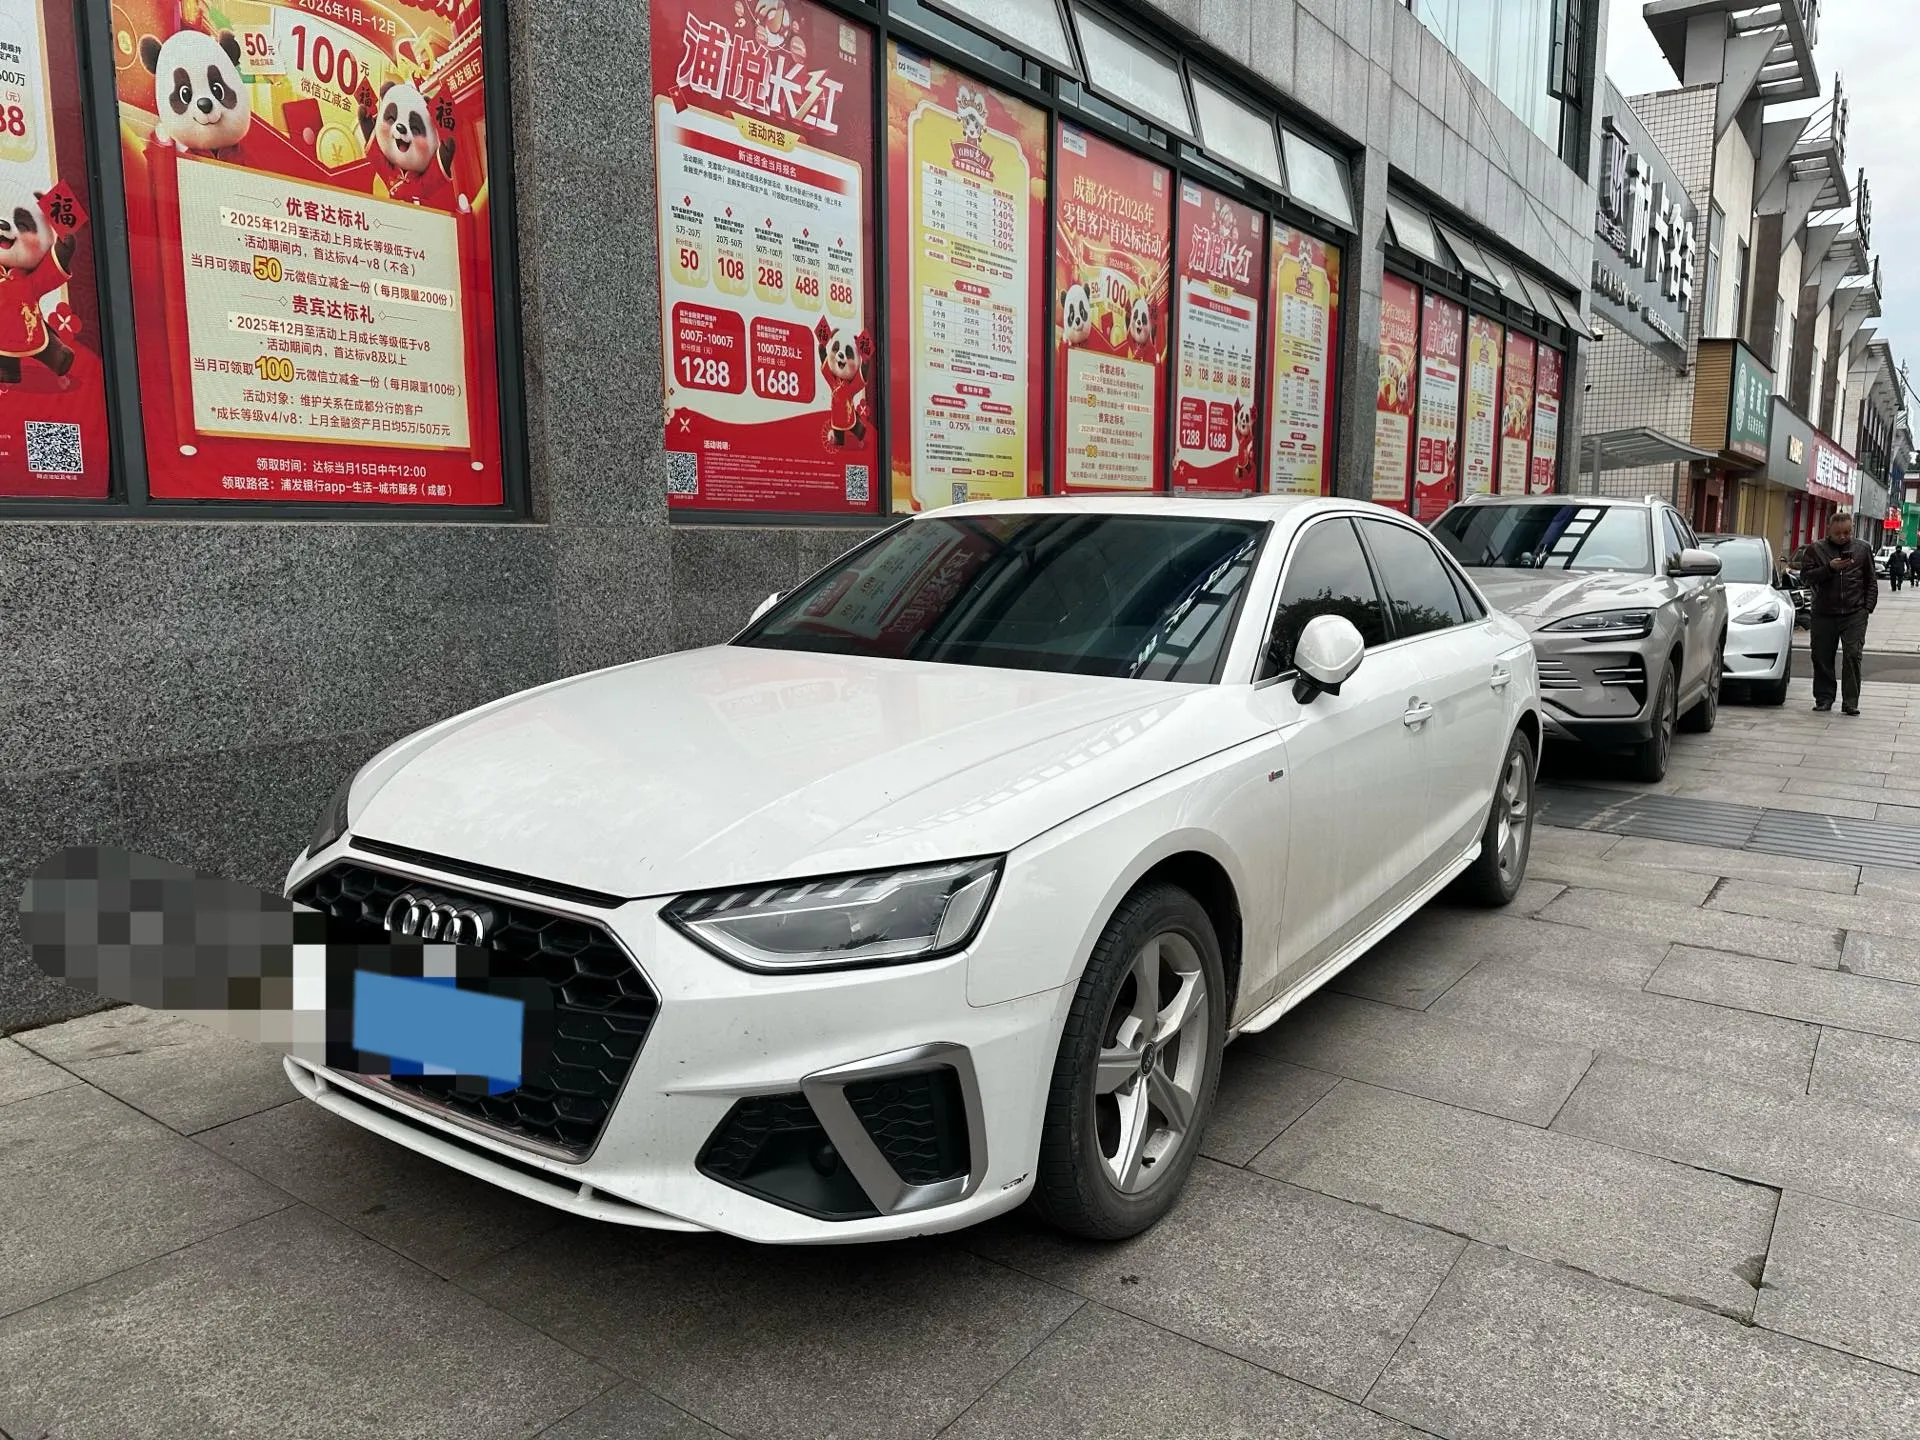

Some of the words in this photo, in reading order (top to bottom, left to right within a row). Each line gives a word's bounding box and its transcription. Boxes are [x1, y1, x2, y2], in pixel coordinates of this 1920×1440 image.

[0, 69, 25, 86] 00万
[446, 58, 481, 93] 浦发银行
[676, 12, 844, 134] 浦悦长红
[301, 79, 352, 112] 微信立减金
[436, 97, 455, 131] 福
[748, 121, 786, 147] 活动内容
[48, 195, 77, 228] 福
[993, 198, 1014, 212] 1.75%
[1072, 175, 1154, 228] 成都分行2026年
[286, 197, 369, 231] 优客达标礼
[993, 208, 1014, 222] 1.40%
[231, 212, 425, 260] 2025年12月至活动上月成长等级低于v4
[993, 228, 1014, 242] 1.20%
[1063, 201, 1162, 259] 零售客户首达标活动
[993, 239, 1014, 253] 1.00%
[680, 248, 699, 270] 50
[717, 257, 744, 280] 108
[758, 266, 783, 290] 288
[795, 275, 819, 297] 488
[830, 283, 853, 304] 888
[1106, 275, 1128, 309] 100
[292, 294, 374, 324] 贵宾达标礼
[992, 312, 1014, 325] 1.40%
[237, 316, 430, 352] 2025年12月至活动上月成长等级低于v8
[680, 329, 734, 348] 600万-1000万
[756, 342, 803, 360] 1000万及以上
[681, 356, 730, 387] 1288
[756, 367, 800, 396] 1688
[1185, 364, 1192, 377] 50
[949, 420, 970, 431] 0.75%
[996, 426, 1016, 436] 0.45%
[1182, 429, 1200, 446] 1288
[1209, 432, 1227, 449] 1688
